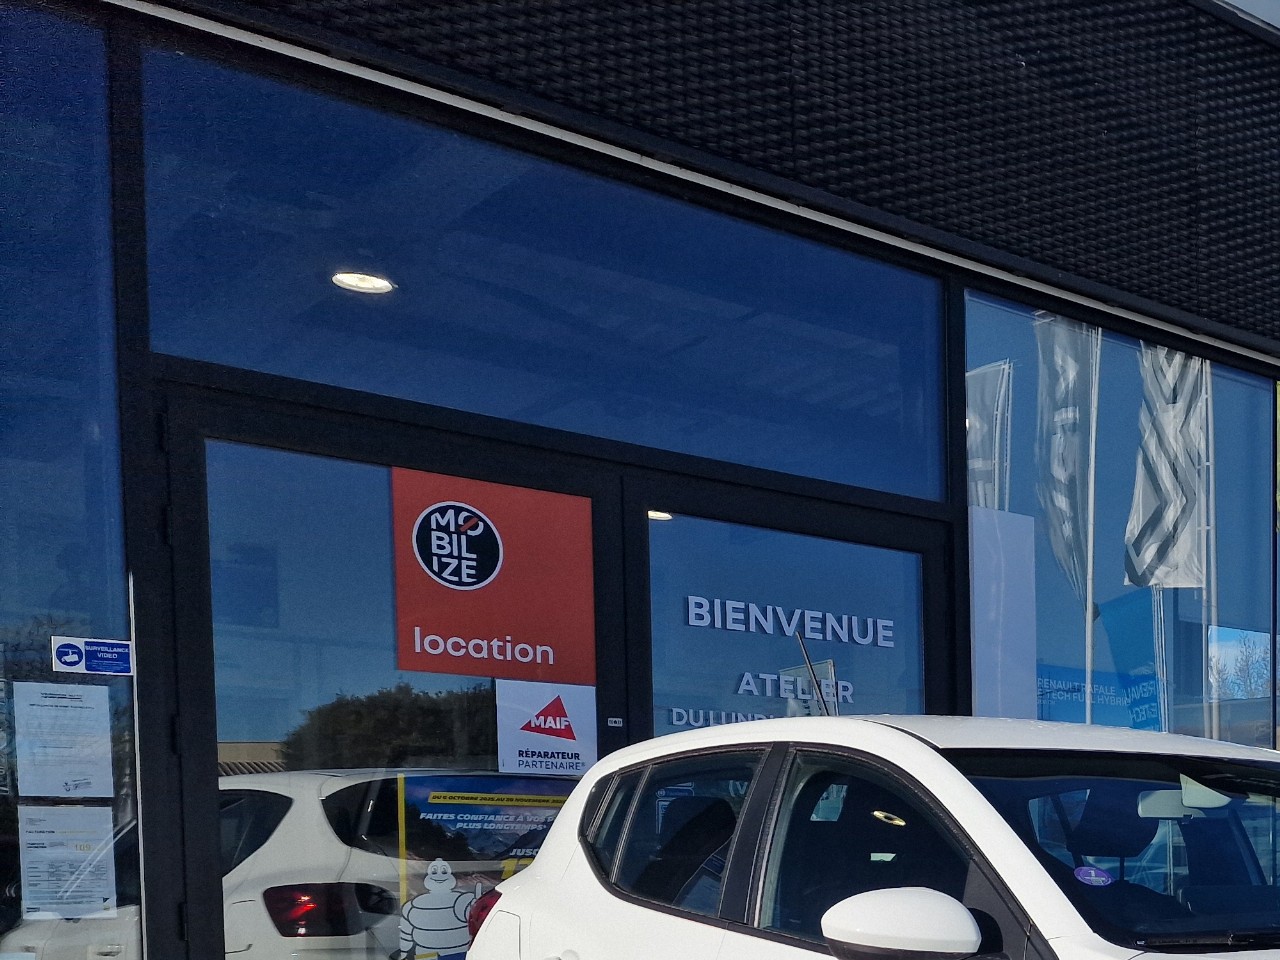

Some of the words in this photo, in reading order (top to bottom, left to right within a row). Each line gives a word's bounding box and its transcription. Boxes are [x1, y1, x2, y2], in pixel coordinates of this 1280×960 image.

[687, 595, 895, 648] BIENVENUE
[414, 626, 554, 665] location
[530, 715, 570, 730] MAIF
[671, 707, 704, 727] DU
[518, 748, 580, 760] RÉPARATEUR
[420, 812, 455, 820] FAITES
[457, 814, 516, 822] CONFIANCE
